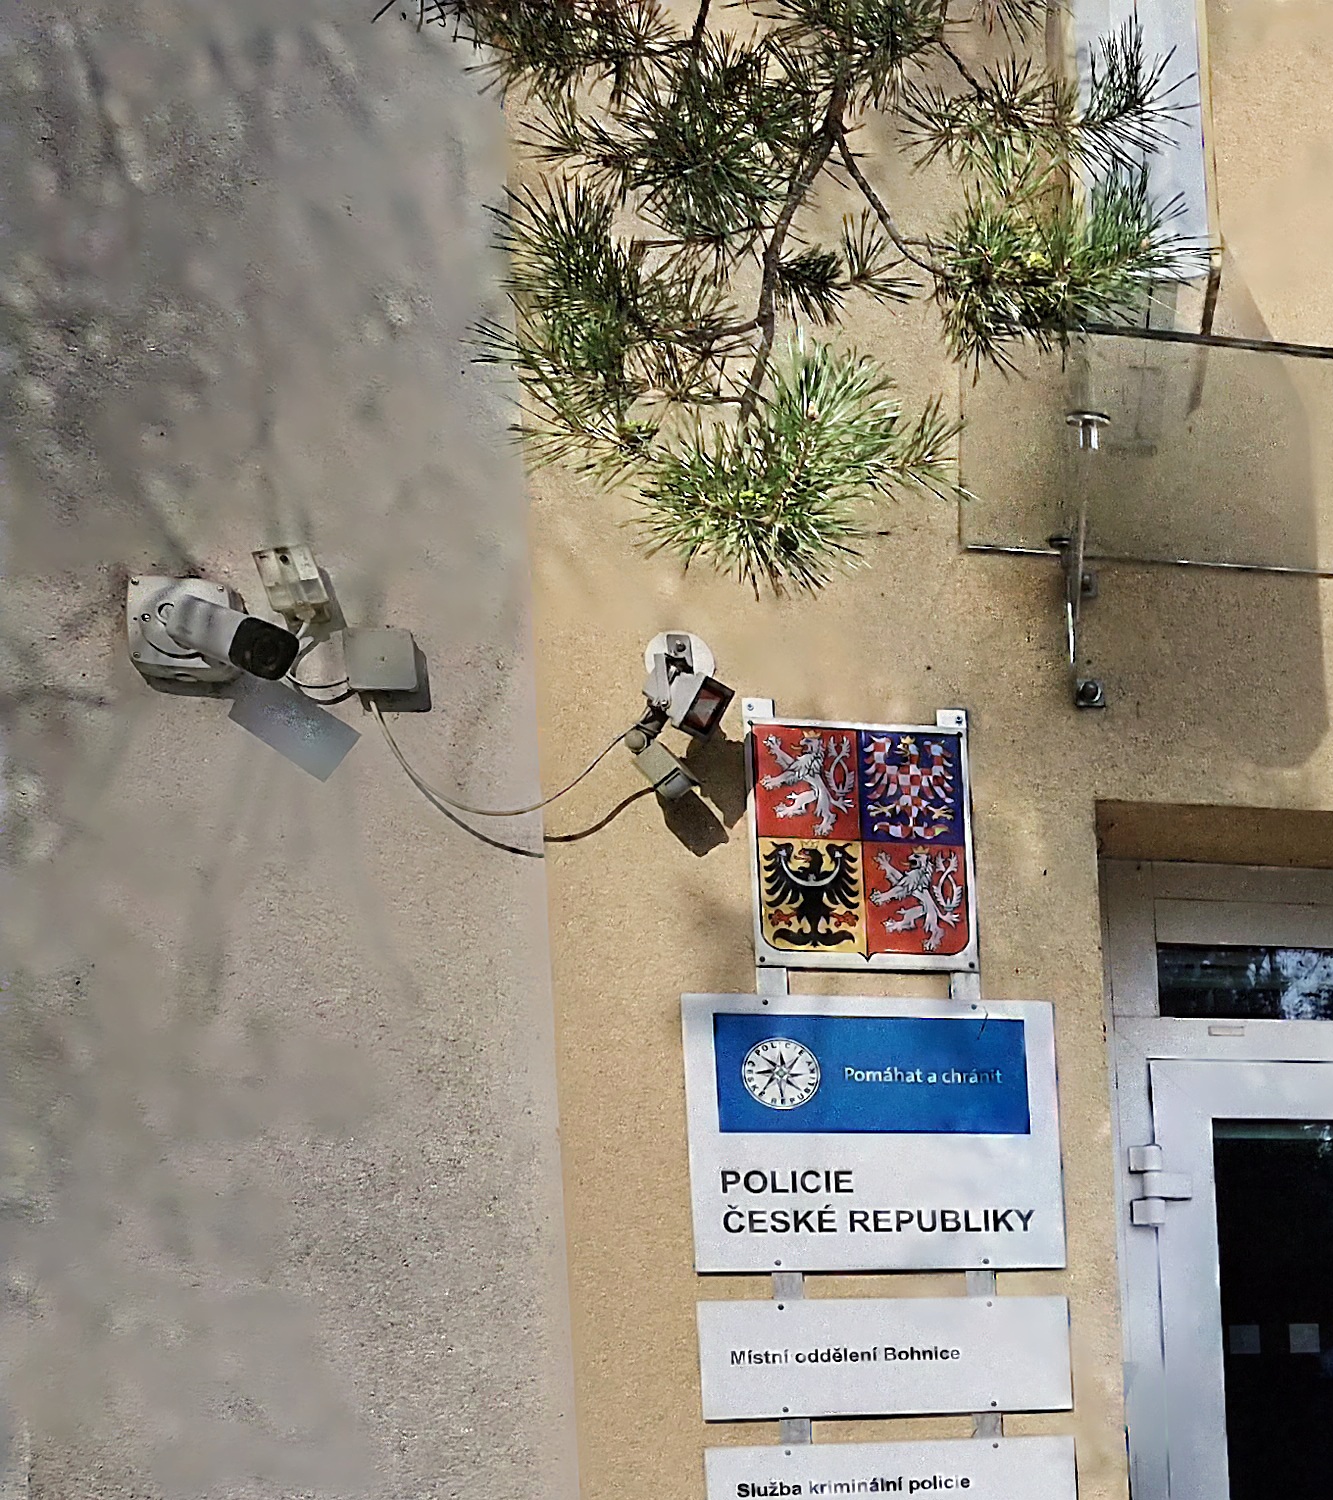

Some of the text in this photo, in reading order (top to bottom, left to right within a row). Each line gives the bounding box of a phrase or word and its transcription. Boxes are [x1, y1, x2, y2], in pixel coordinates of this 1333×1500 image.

[844, 1067, 1003, 1084] Pomáhat a chránit
[721, 1170, 854, 1193] POLICIE
[723, 1204, 1034, 1233] ČESKÉ REPUBLIKY
[730, 1346, 960, 1365] Místní oddělení Bohnice
[737, 1475, 970, 1497] Služba kriminální policie
